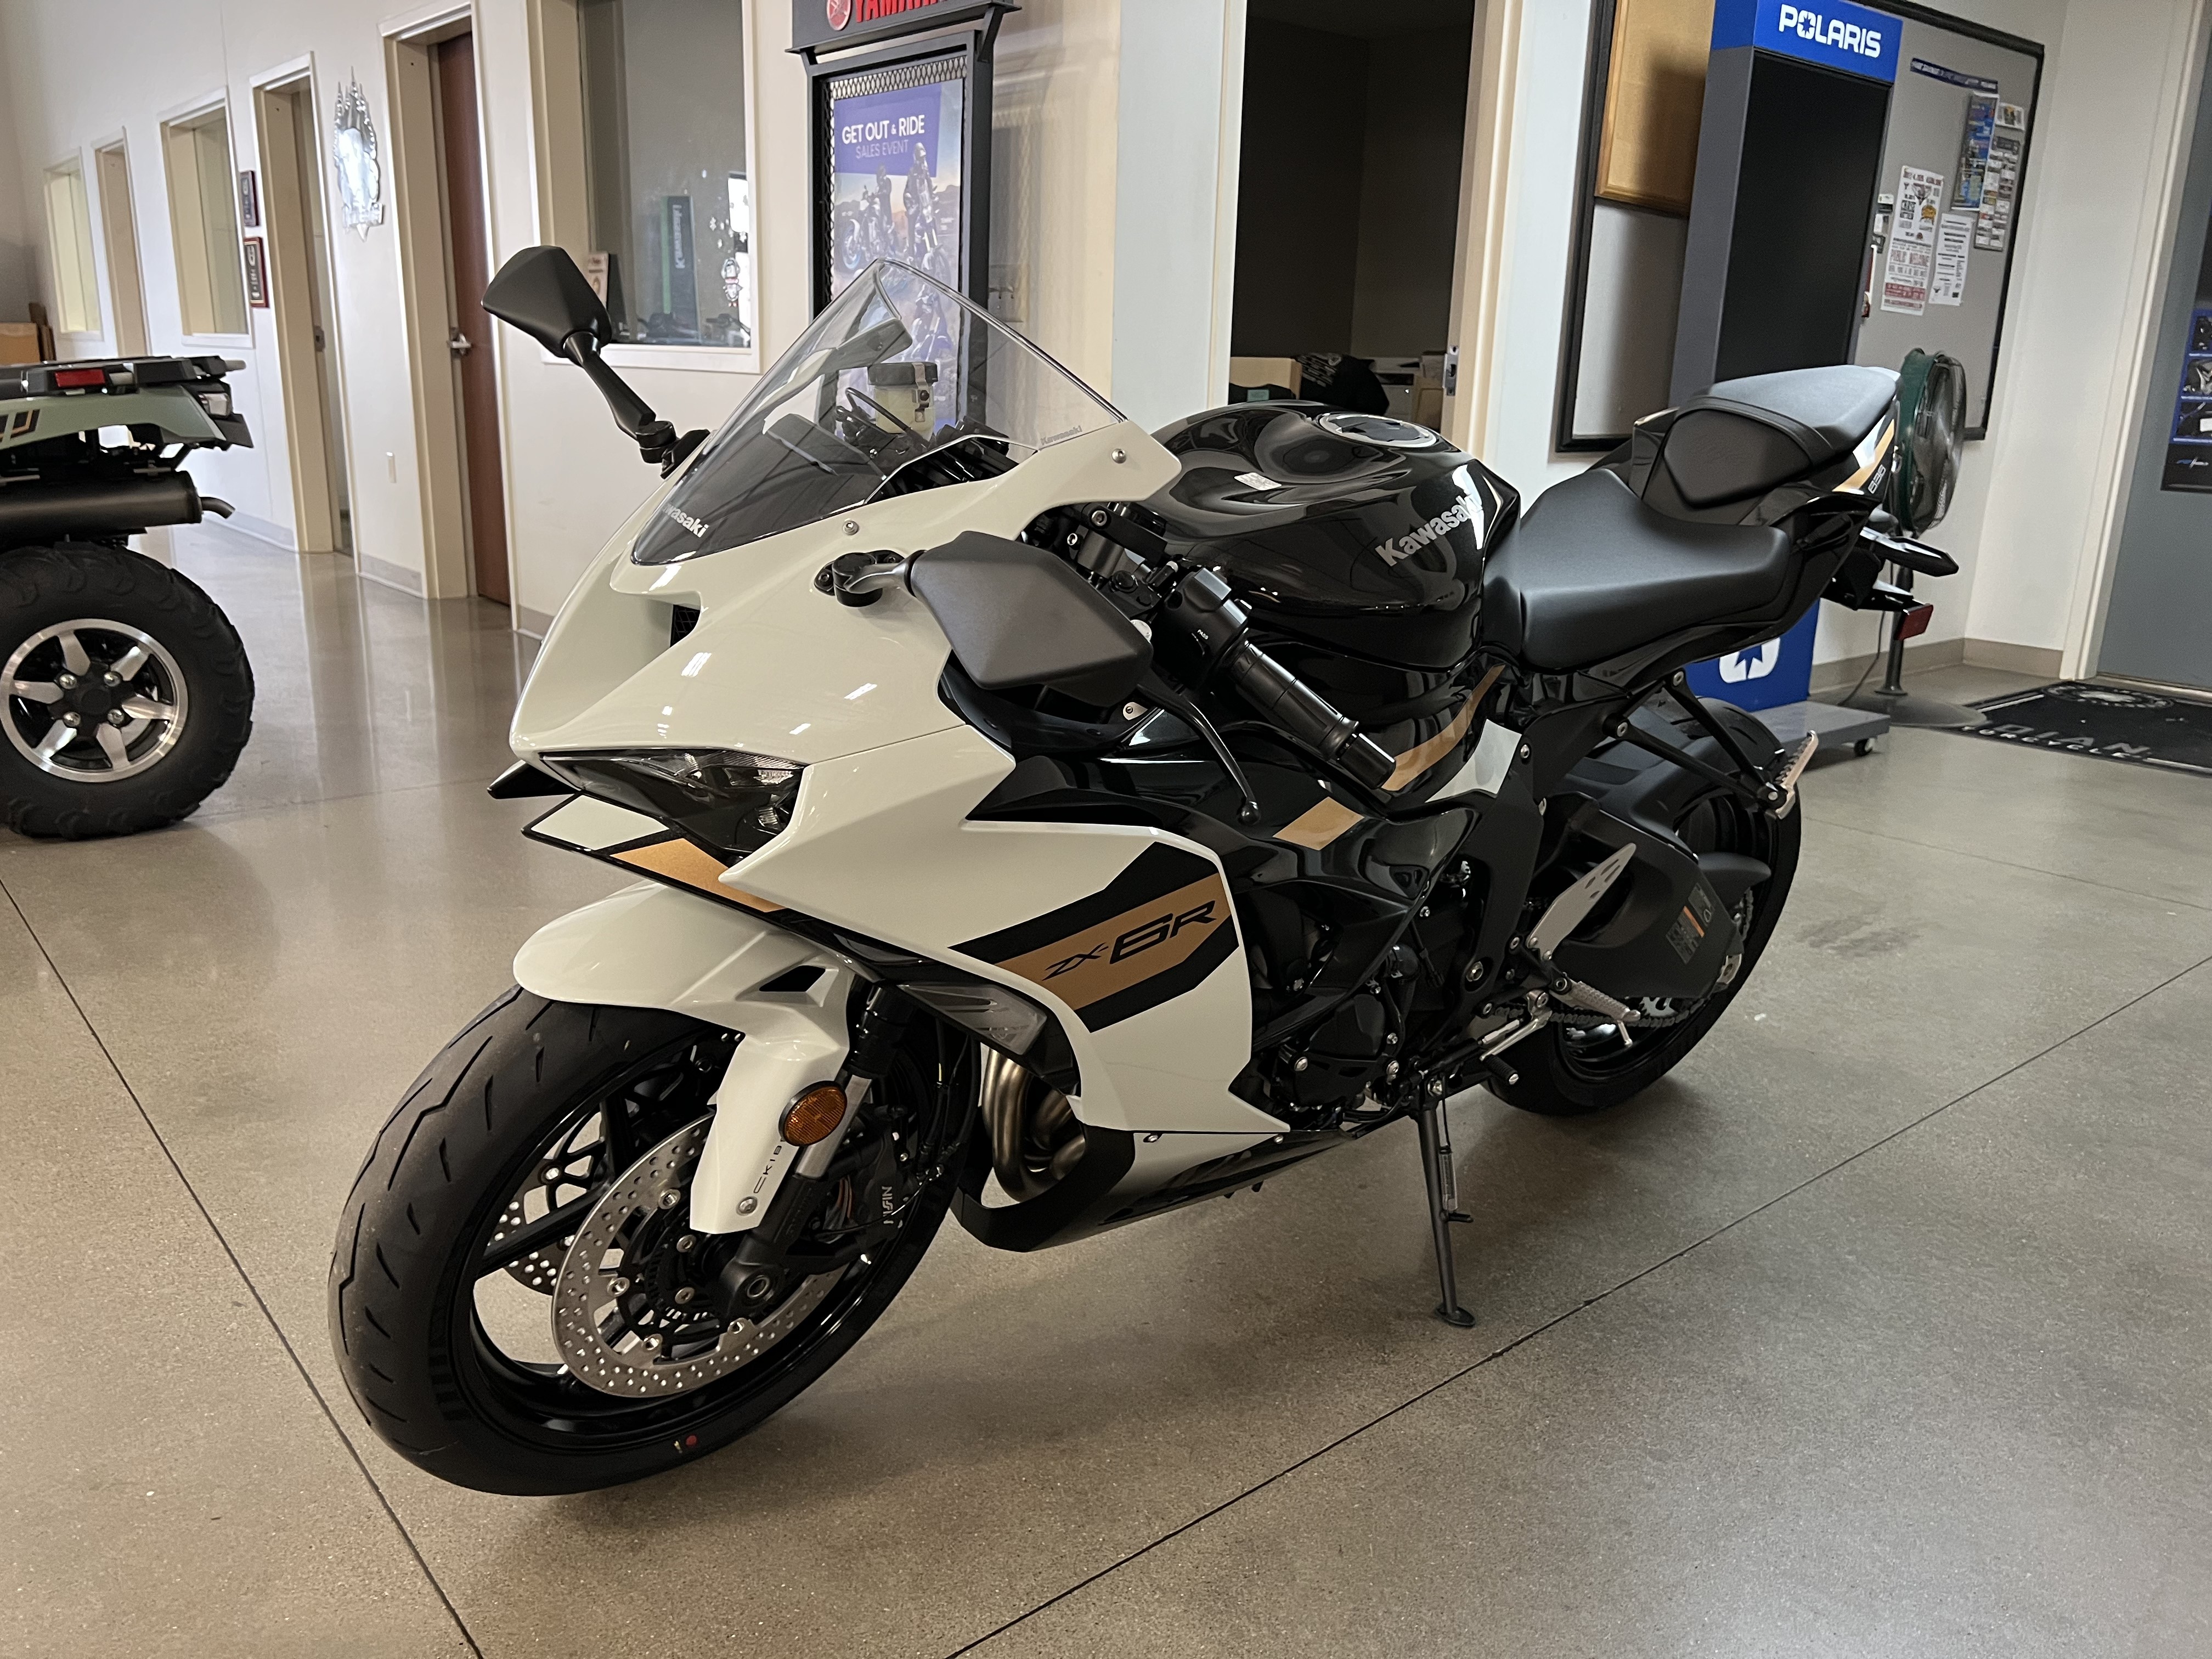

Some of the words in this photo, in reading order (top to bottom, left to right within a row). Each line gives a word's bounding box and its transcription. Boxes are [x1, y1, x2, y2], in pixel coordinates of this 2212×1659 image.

[1779, 4, 1881, 58] POLARIS
[842, 125, 864, 144] GET
[865, 120, 890, 141] OUT
[891, 124, 897, 134] &
[899, 115, 925, 137] RIDE
[856, 143, 881, 159] SALES
[882, 139, 909, 156] EVENT
[1040, 425, 1082, 445] Kawasaki
[1993, 724, 2152, 754] DIAN
